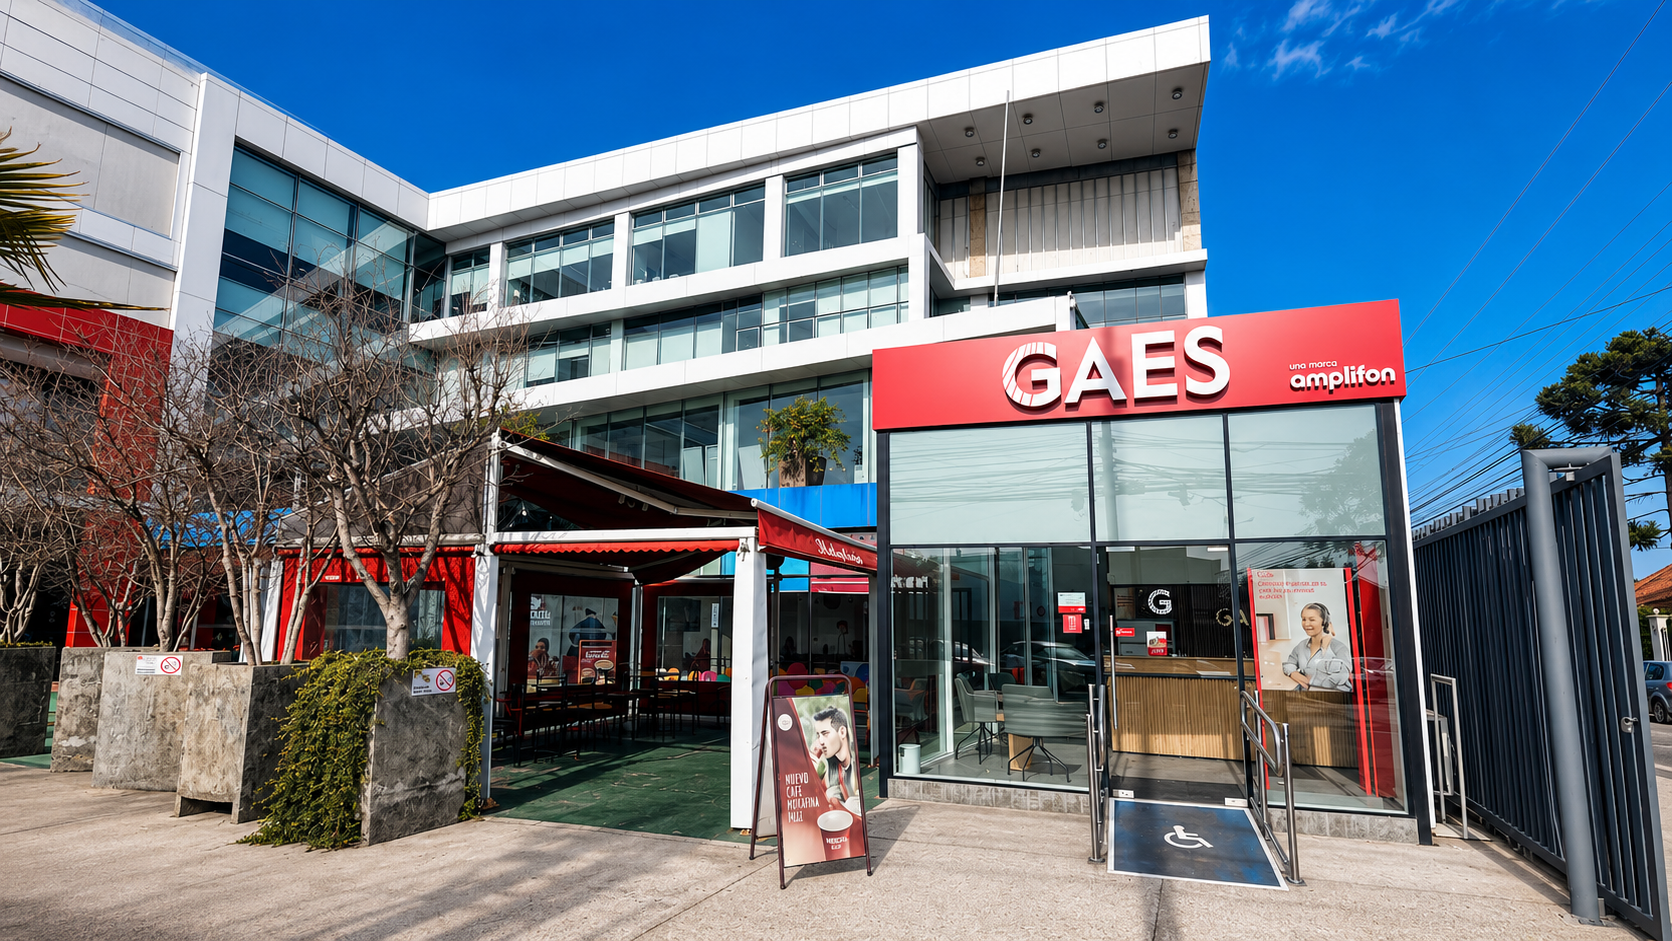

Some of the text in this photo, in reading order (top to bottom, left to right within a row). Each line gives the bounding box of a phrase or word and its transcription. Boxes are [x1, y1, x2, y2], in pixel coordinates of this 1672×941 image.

[1002, 325, 1231, 409] GAES
[1289, 360, 1338, 371] una marca
[1290, 364, 1396, 391] amplifon
[1147, 588, 1173, 615] G
[785, 772, 809, 786] NUEVO
